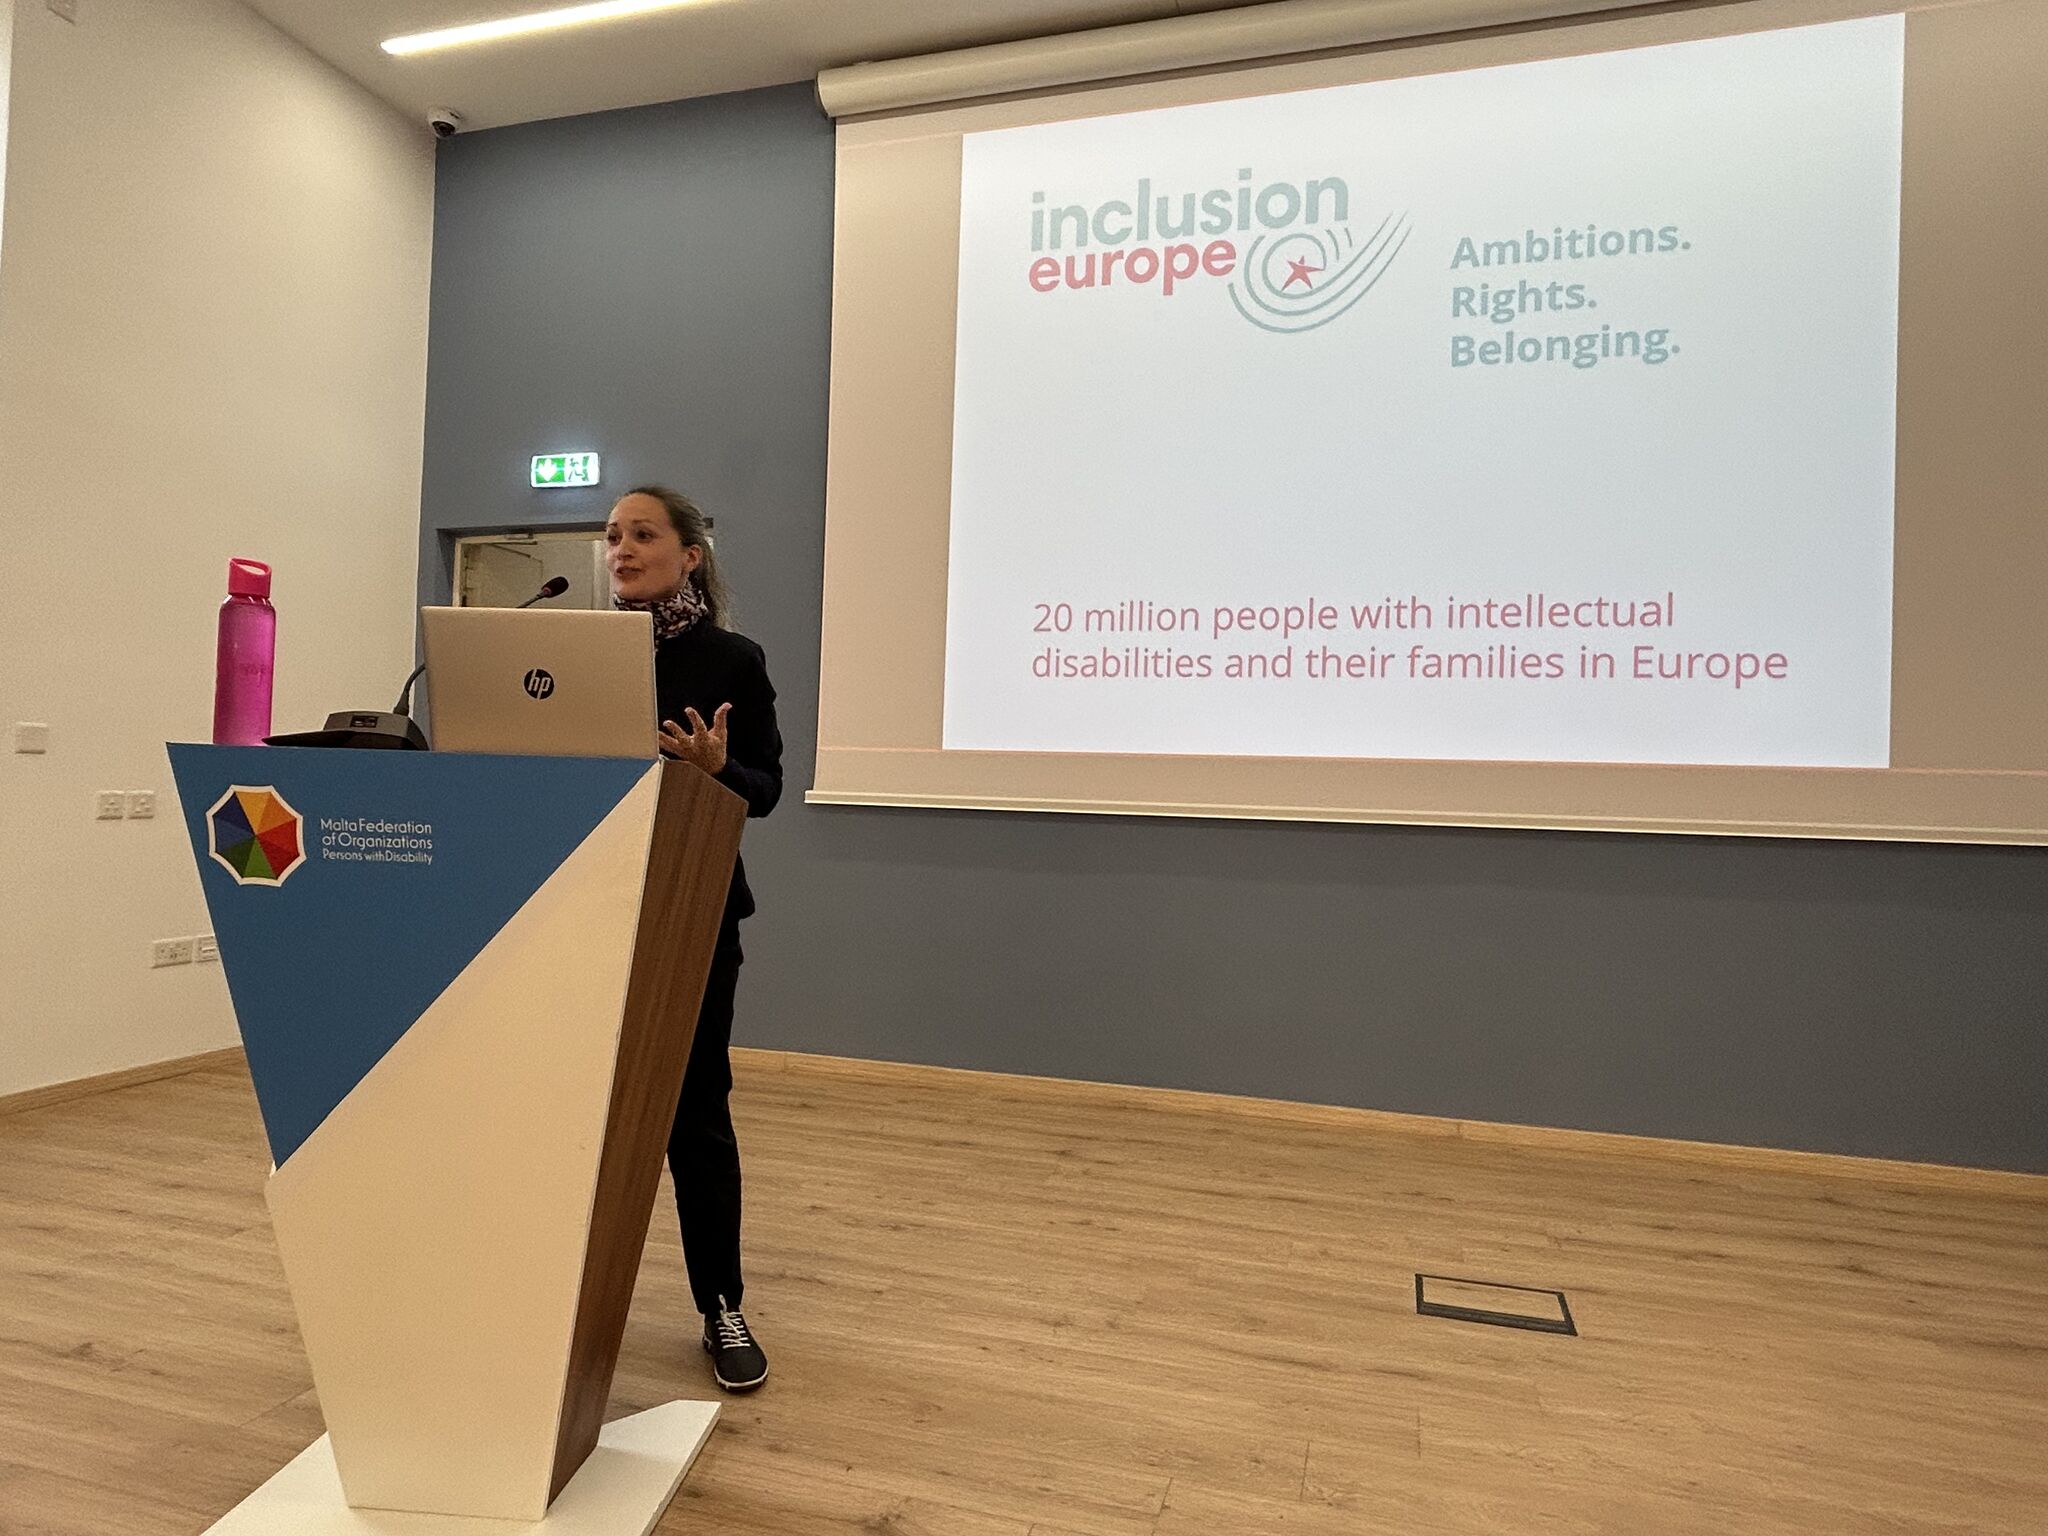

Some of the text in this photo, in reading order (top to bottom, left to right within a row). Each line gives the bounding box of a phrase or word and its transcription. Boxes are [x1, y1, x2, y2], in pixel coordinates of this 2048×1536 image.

[1030, 167, 1349, 252] inclusion
[1029, 239, 1236, 296] europe
[1450, 224, 1691, 269] Ambitions.
[1452, 280, 1597, 323] Rights.
[1451, 324, 1680, 368] Belonging.
[1032, 592, 1674, 639] 20 million people with intellectual
[527, 668, 552, 700] hp
[1032, 645, 1788, 689] disabilities and their families in Europe
[322, 831, 433, 851] of Organizations
[322, 848, 363, 861] Persons
